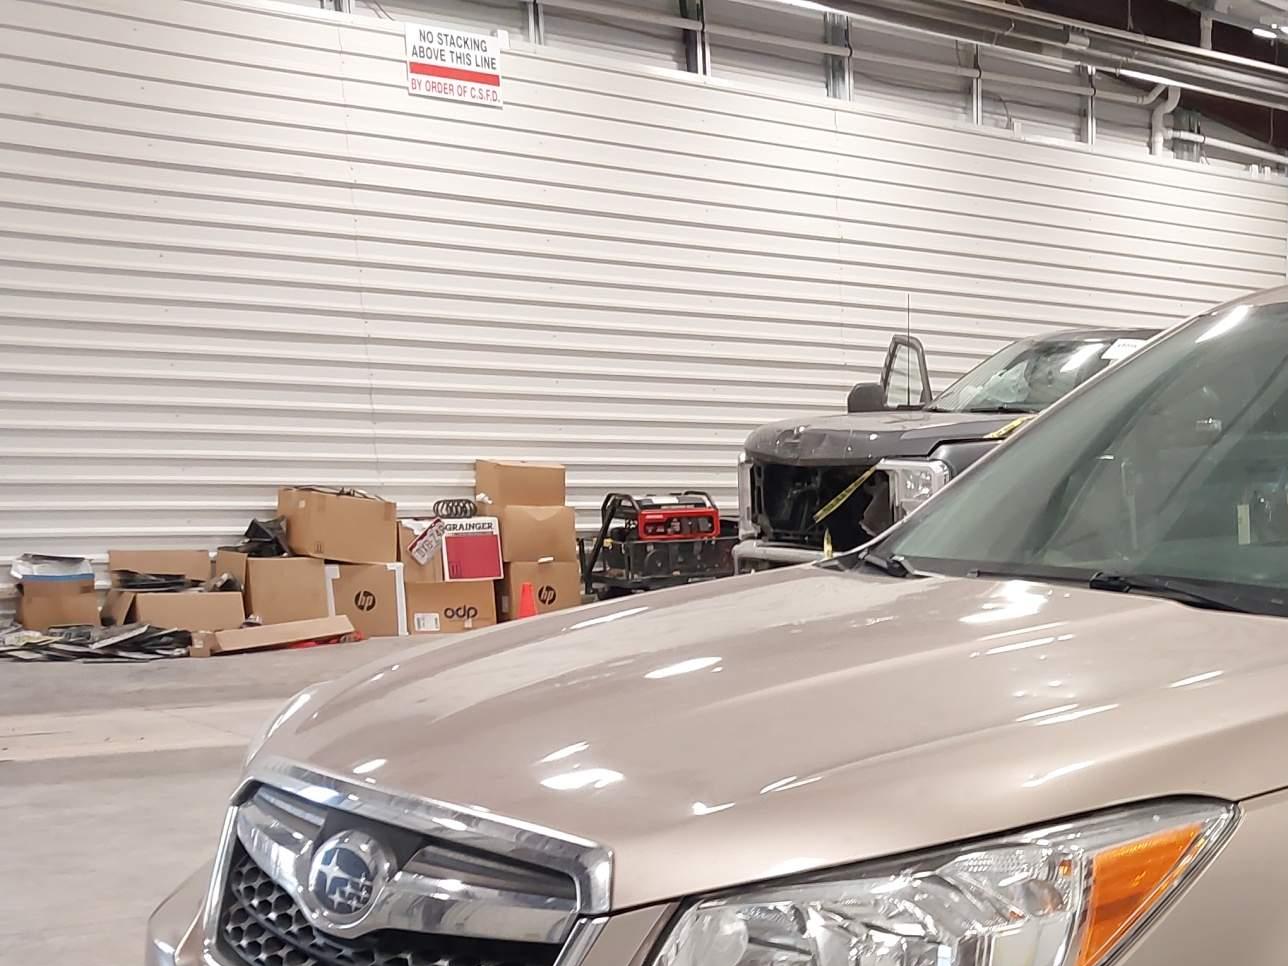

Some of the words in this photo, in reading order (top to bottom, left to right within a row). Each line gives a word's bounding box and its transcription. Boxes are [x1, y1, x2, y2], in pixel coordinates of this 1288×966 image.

[419, 29, 434, 44] NO
[437, 32, 488, 53] STACKING
[411, 45, 447, 63] ABOVE
[449, 50, 472, 67] THIS
[475, 54, 497, 71] LINE
[411, 78, 423, 91] BY
[424, 80, 455, 96] ORDER
[457, 85, 469, 98] OF
[469, 86, 501, 103] C.S.F.D.
[445, 522, 494, 532] GRAINGER
[357, 590, 375, 611] hp
[540, 585, 556, 606] hp
[444, 604, 478, 619] odp
